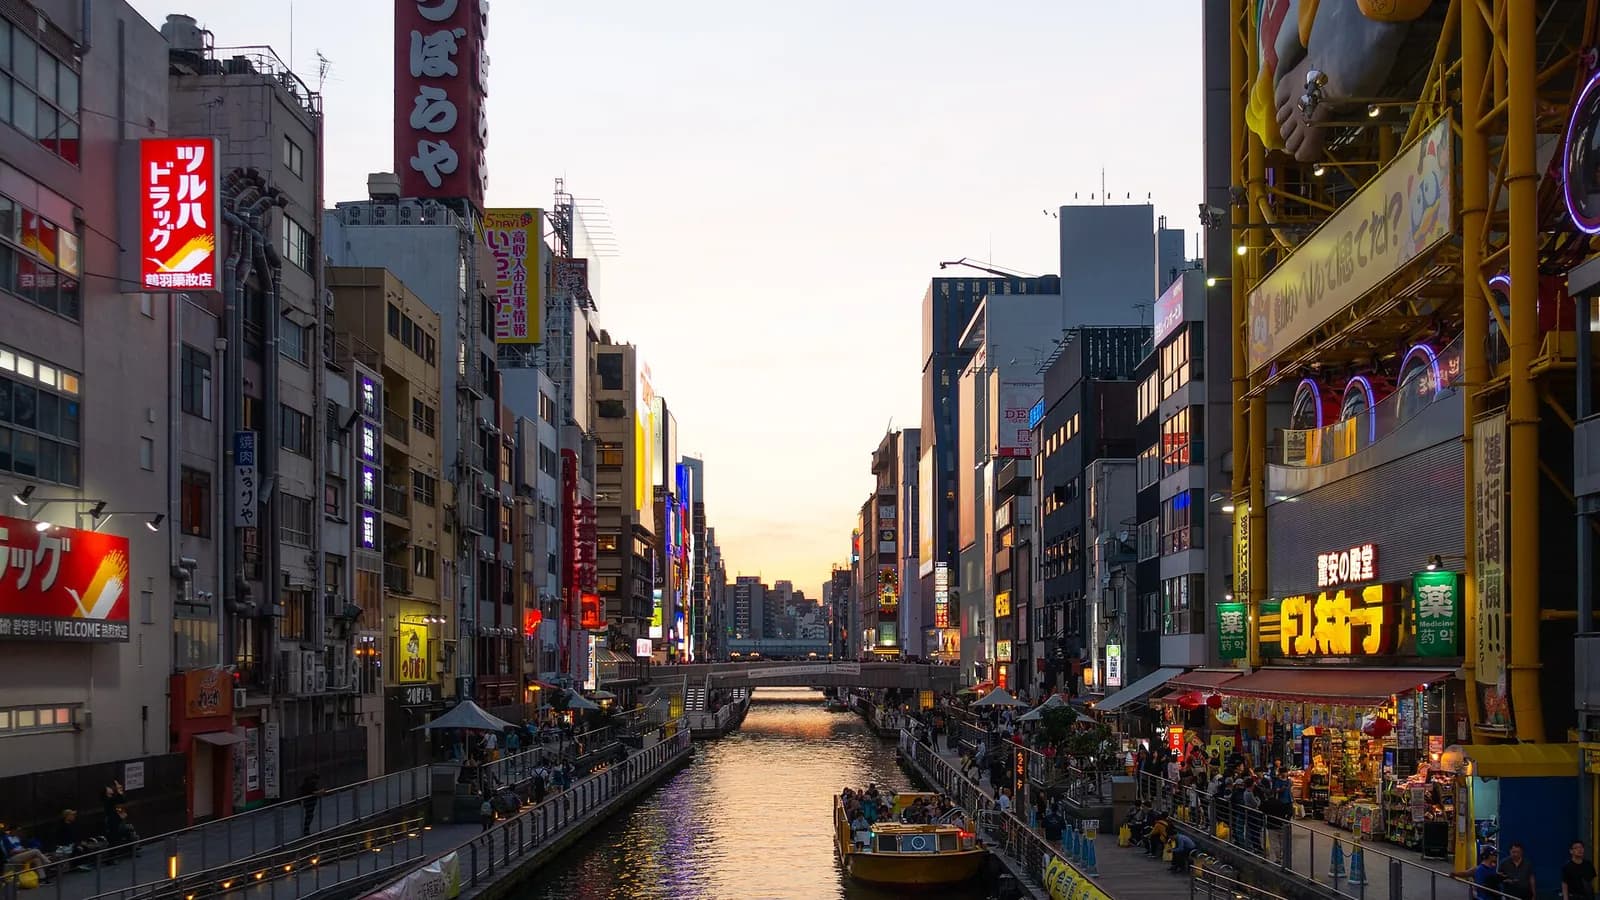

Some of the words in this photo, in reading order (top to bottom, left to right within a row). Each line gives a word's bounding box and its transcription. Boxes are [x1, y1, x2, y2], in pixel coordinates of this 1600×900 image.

[176, 146, 207, 230] ツルハ
[149, 161, 175, 252] ドラッグ
[512, 230, 526, 337] 高収入お仕事情報
[239, 432, 254, 465] 焼肉
[1317, 544, 1374, 587] 驚安の殿堂
[1418, 584, 1454, 618] 薬
[13, 618, 53, 636] 환영합니다
[54, 621, 101, 638] WELCOME
[1220, 611, 1244, 633] 薬
[1420, 629, 1435, 644] 药
[1440, 628, 1454, 644] 약
